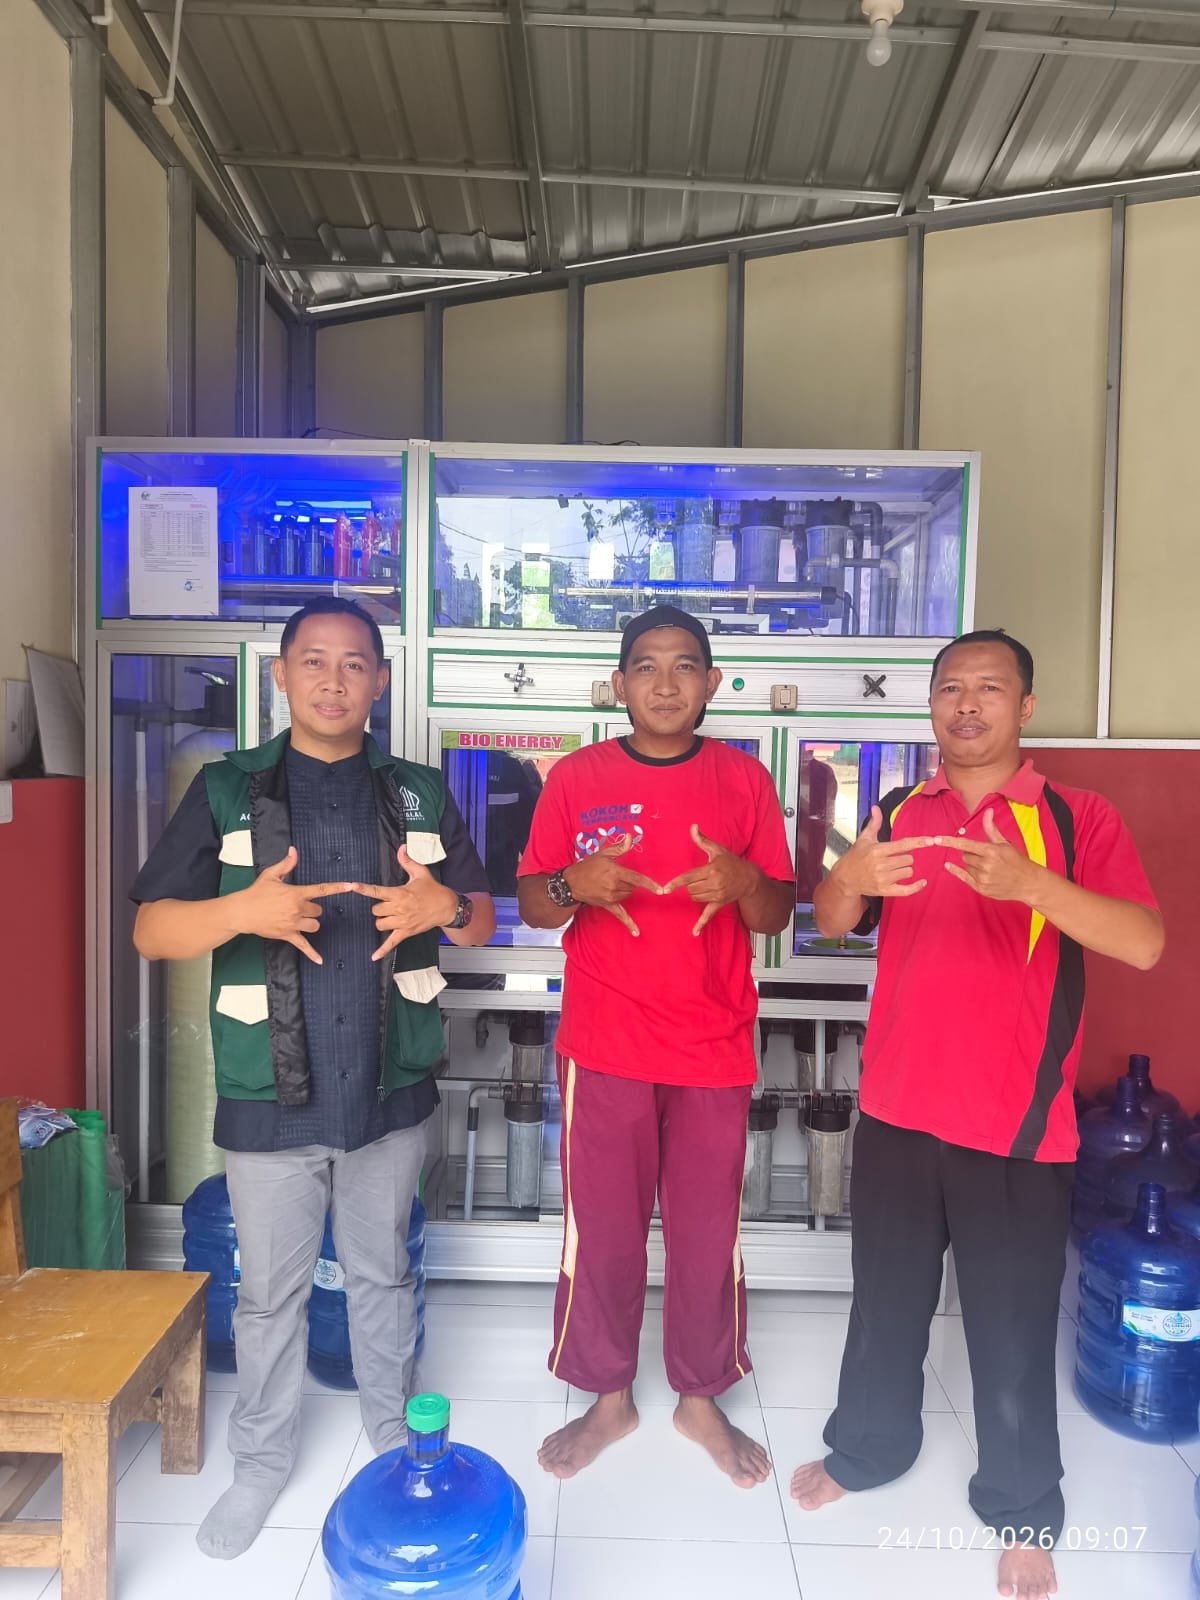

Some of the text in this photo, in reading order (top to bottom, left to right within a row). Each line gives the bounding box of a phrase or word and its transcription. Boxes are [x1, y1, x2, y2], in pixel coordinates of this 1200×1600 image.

[459, 732, 563, 749] BIO ENERGY
[580, 804, 627, 819] KOKOH
